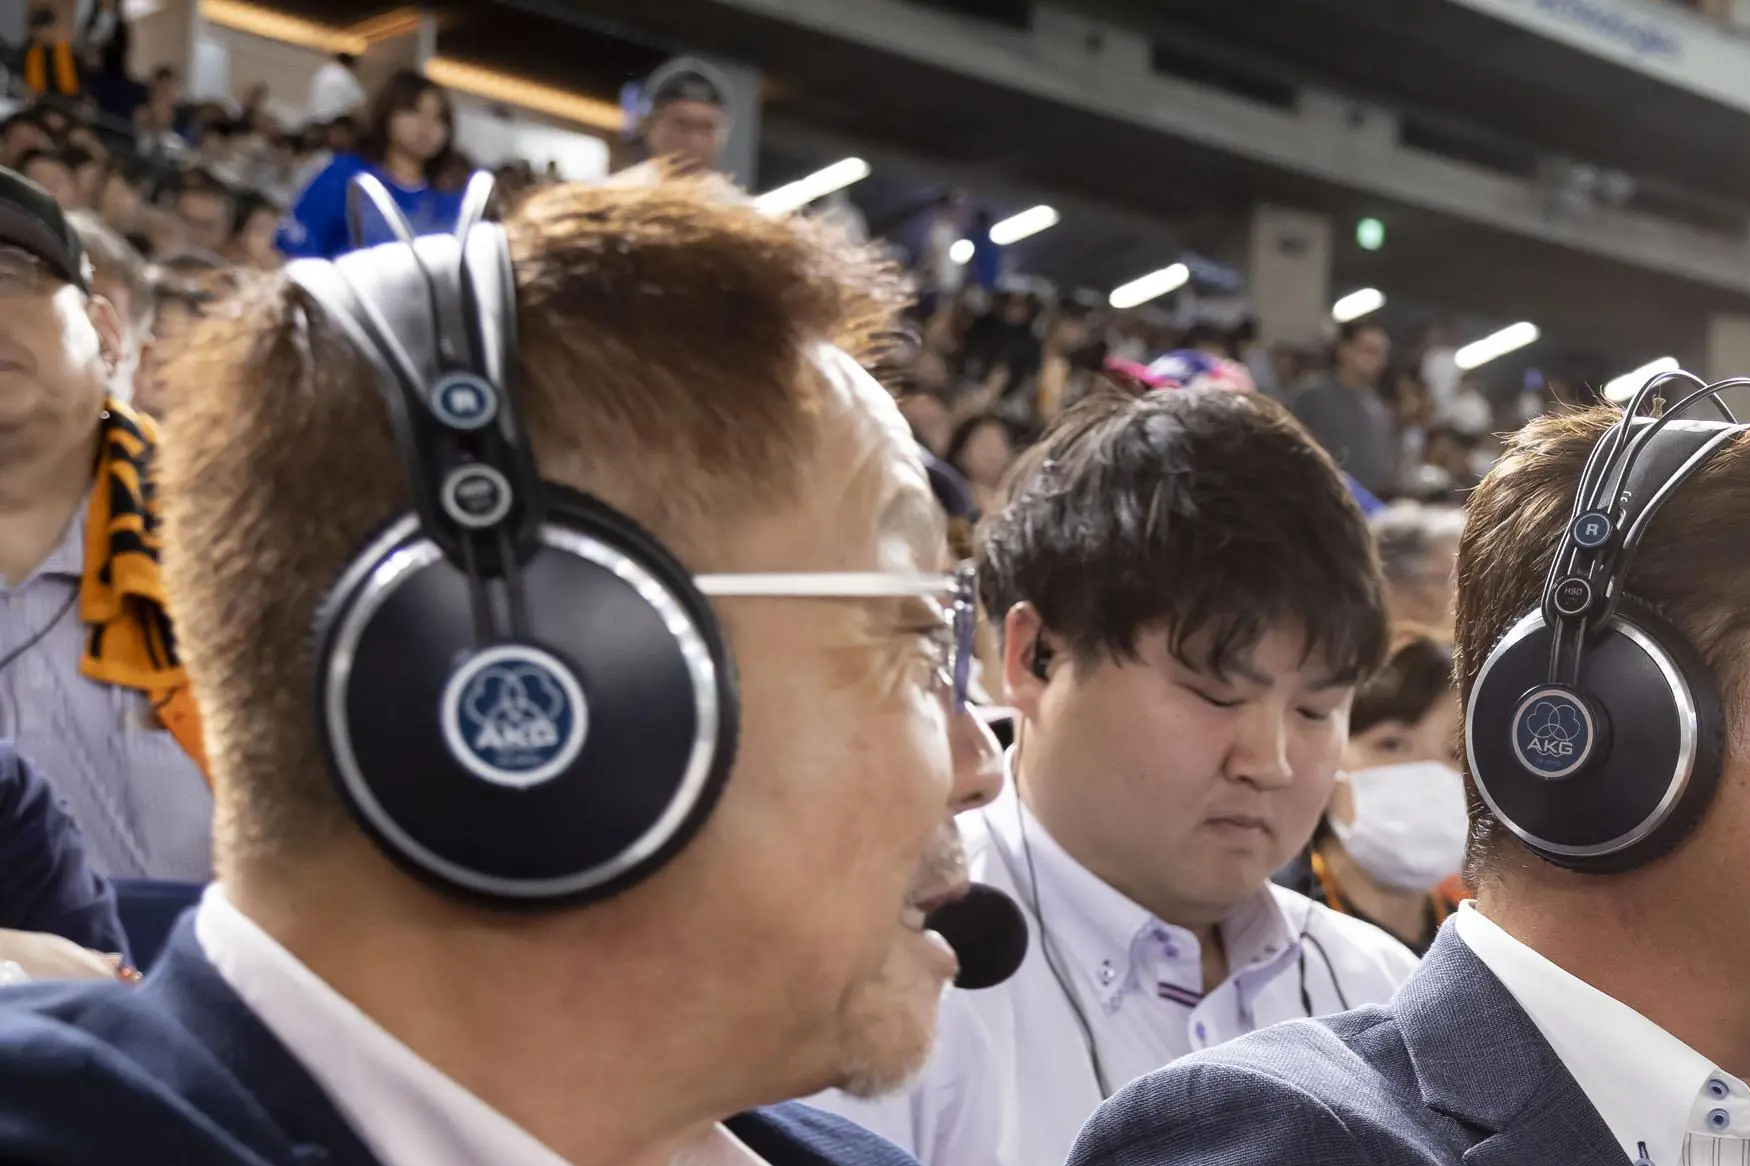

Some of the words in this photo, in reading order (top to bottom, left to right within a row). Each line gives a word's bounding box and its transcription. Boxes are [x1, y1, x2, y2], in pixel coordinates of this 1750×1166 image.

[1585, 523, 1599, 536] R
[475, 717, 560, 750] AKG
[1527, 738, 1575, 755] AKG
